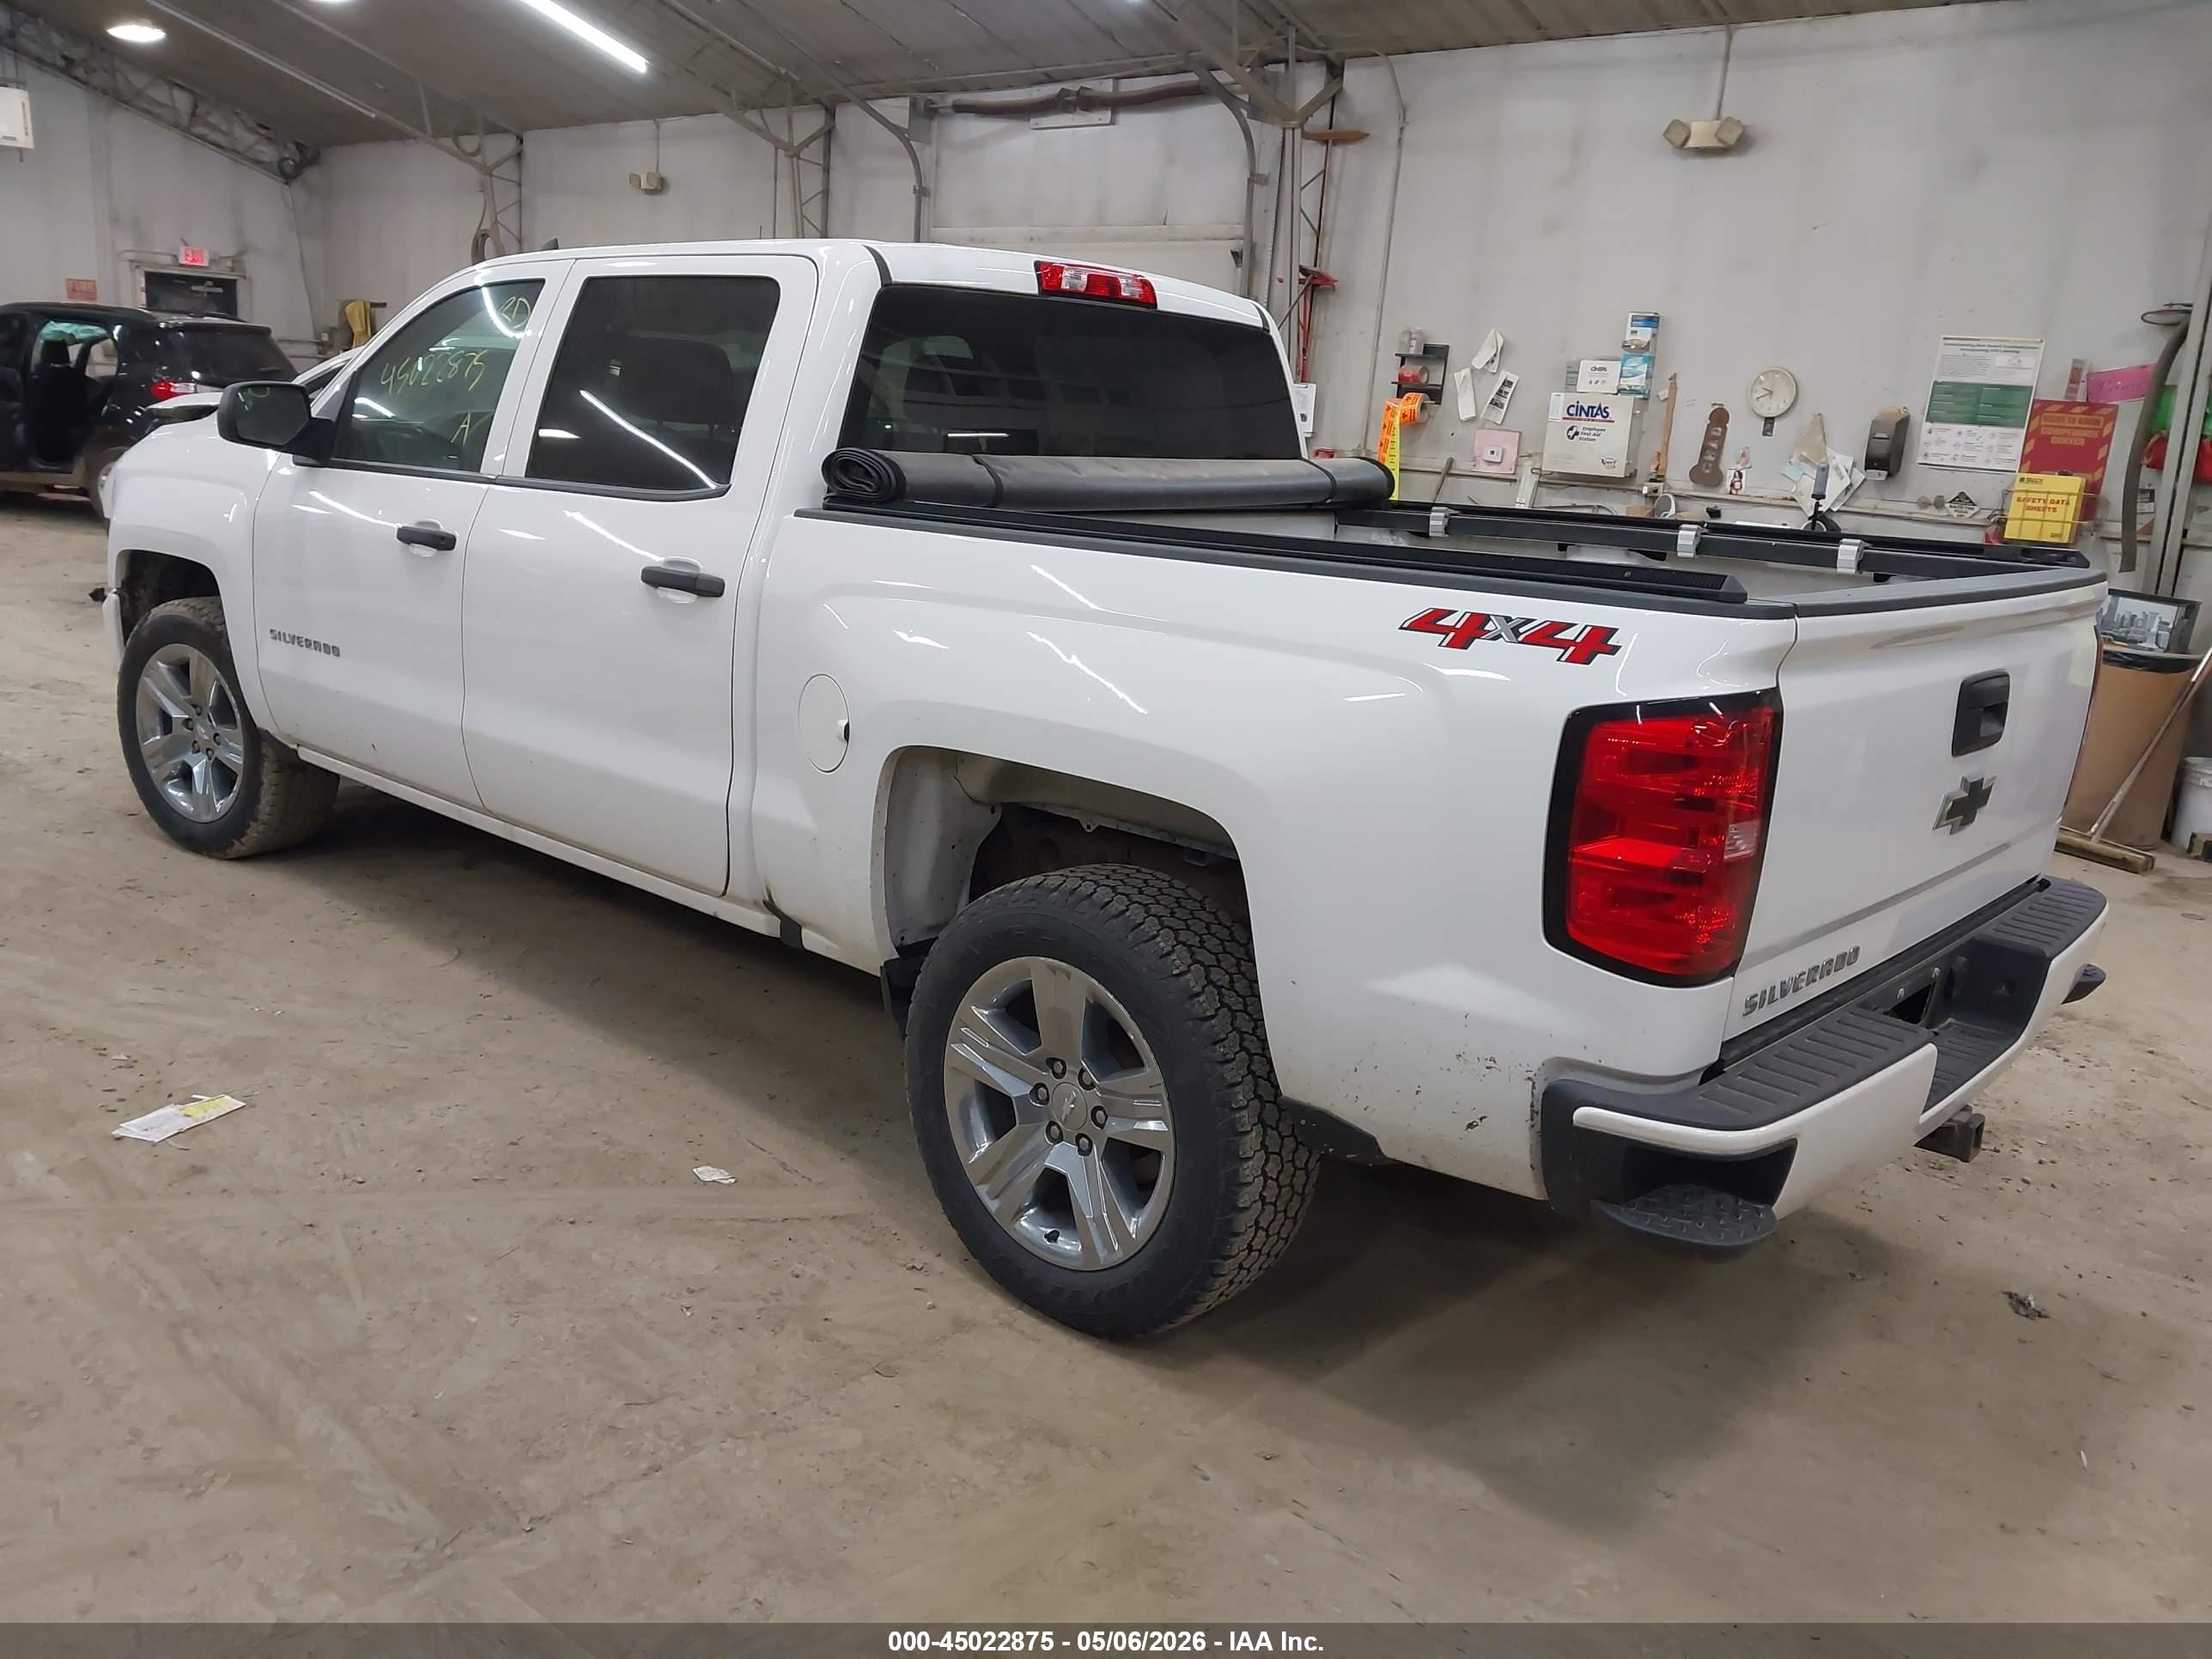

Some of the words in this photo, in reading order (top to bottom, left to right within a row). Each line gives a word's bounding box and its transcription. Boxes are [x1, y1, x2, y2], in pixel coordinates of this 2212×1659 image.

[1566, 400, 1610, 419] CINTAS
[2026, 505, 2057, 514] SHEETS
[269, 629, 340, 658] SILVERADO
[1742, 945, 1861, 1017] SILVERADO
